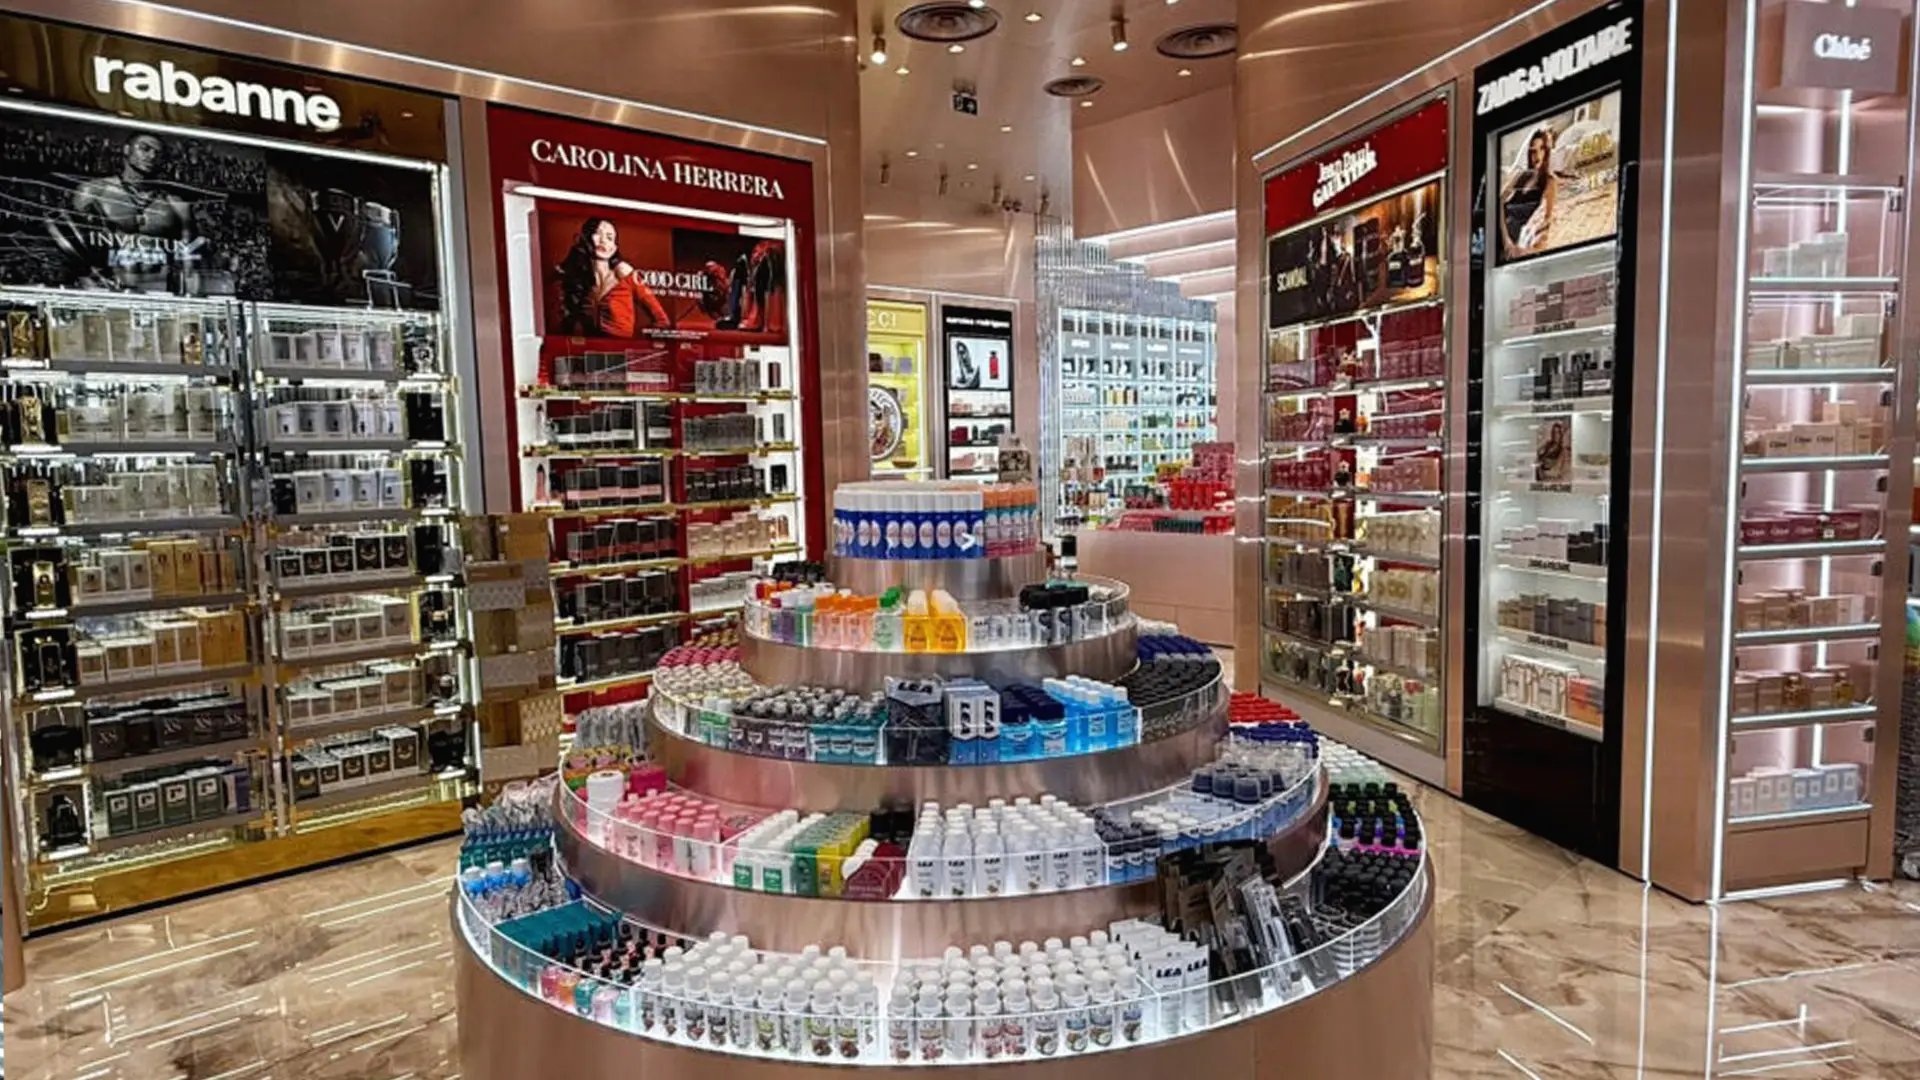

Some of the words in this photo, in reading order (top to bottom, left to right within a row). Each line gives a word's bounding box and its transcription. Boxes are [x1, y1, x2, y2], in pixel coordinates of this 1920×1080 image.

[1813, 33, 1872, 61] Chloé
[93, 56, 342, 132] rabanne
[530, 139, 667, 181] CAROLINA
[673, 162, 785, 200] HERRERA
[898, 682, 934, 695] LEA
[960, 702, 971, 735] LEA
[984, 700, 994, 734] LEA
[1156, 967, 1182, 978] LEA
[1187, 958, 1207, 973] LEA
